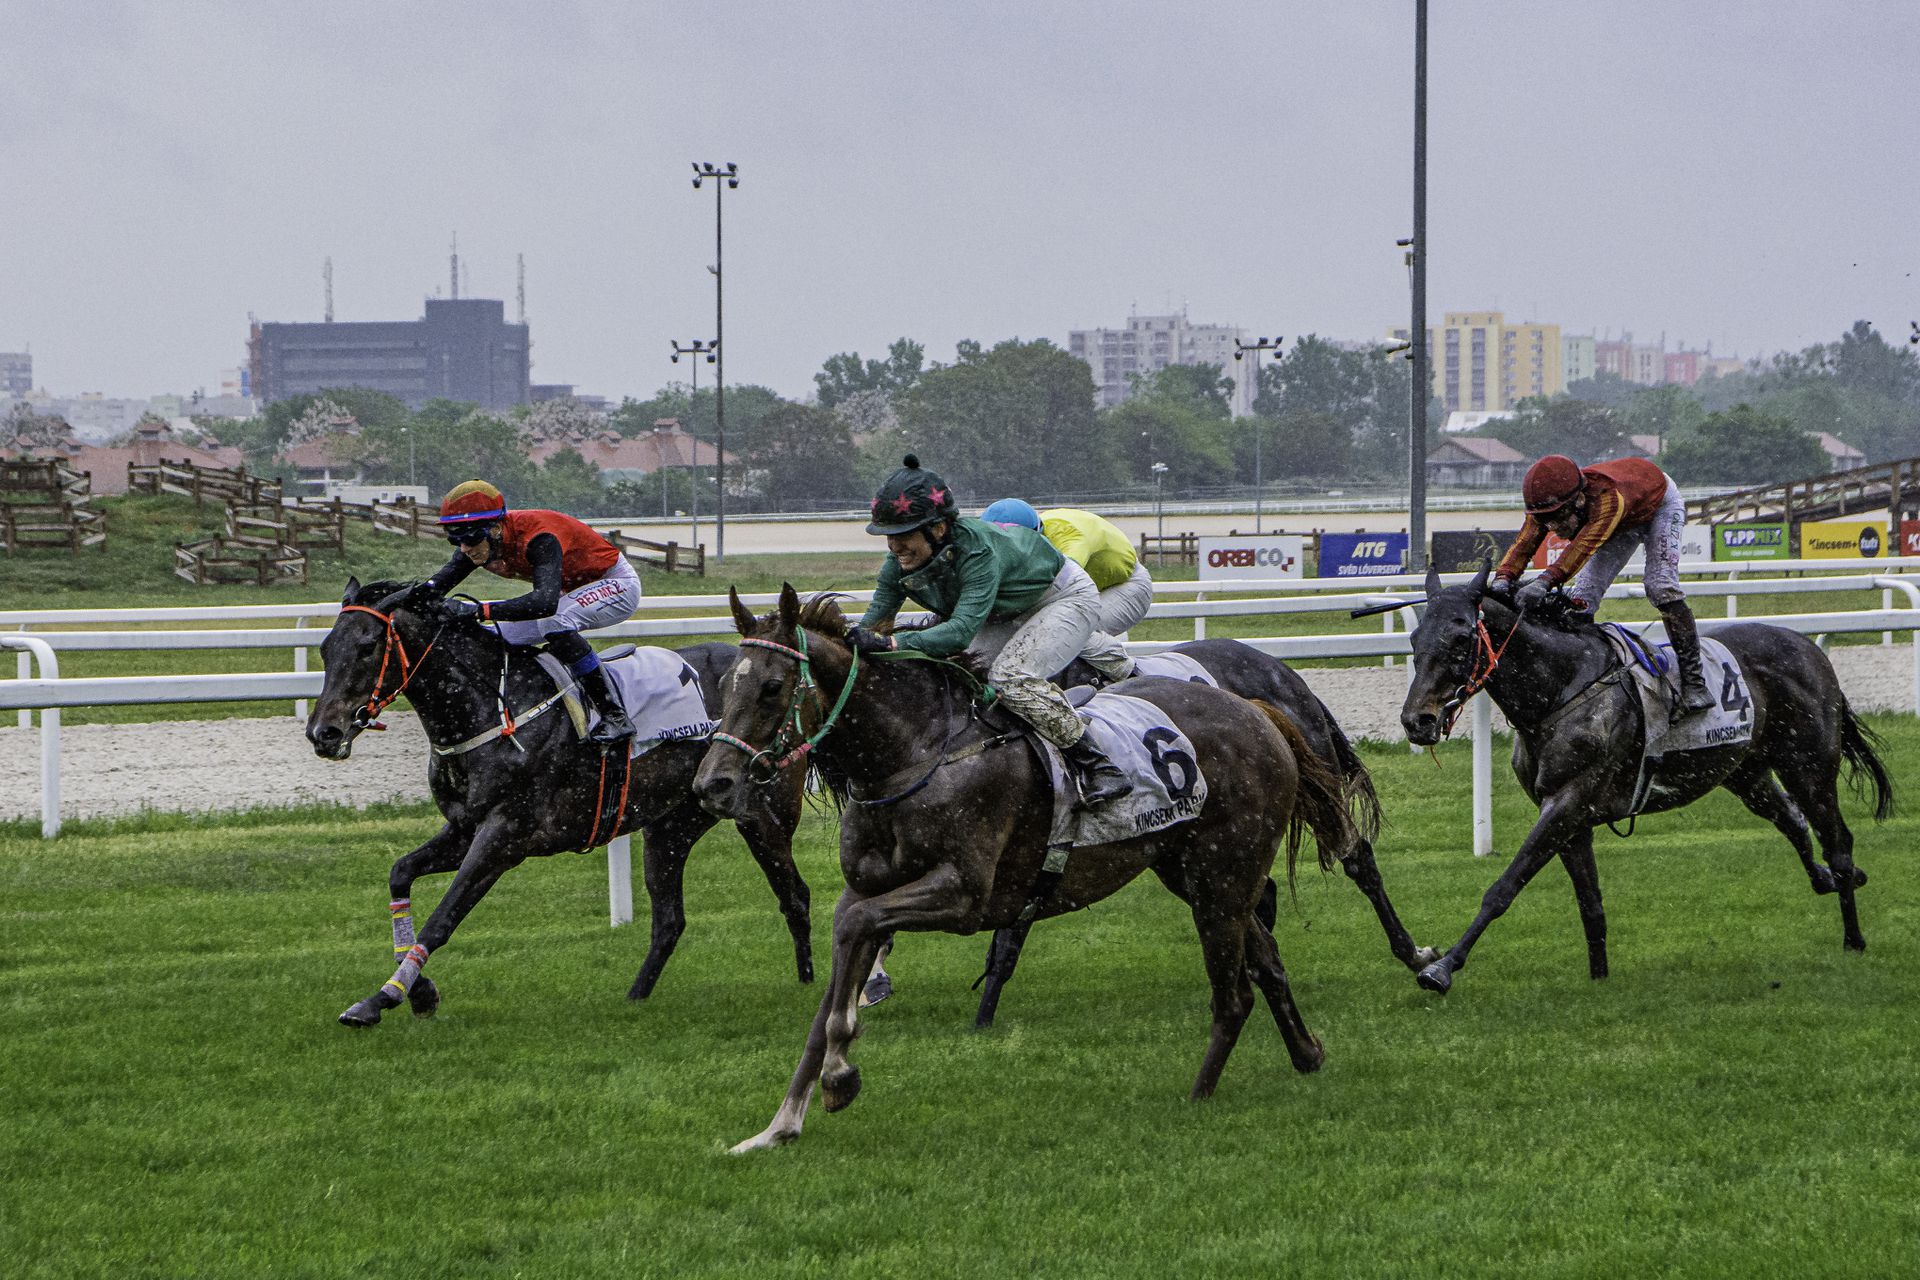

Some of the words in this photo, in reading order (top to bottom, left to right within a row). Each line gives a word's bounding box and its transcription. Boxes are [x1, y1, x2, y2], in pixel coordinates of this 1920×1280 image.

[1208, 548, 1284, 568] ORBICO
[1351, 541, 1387, 558] ATG
[1338, 563, 1358, 575] SVÉD
[575, 591, 599, 608] RED
[1720, 661, 1750, 721] 4
[1142, 726, 1198, 801] 6
[1134, 806, 1176, 832] KINCSEM
